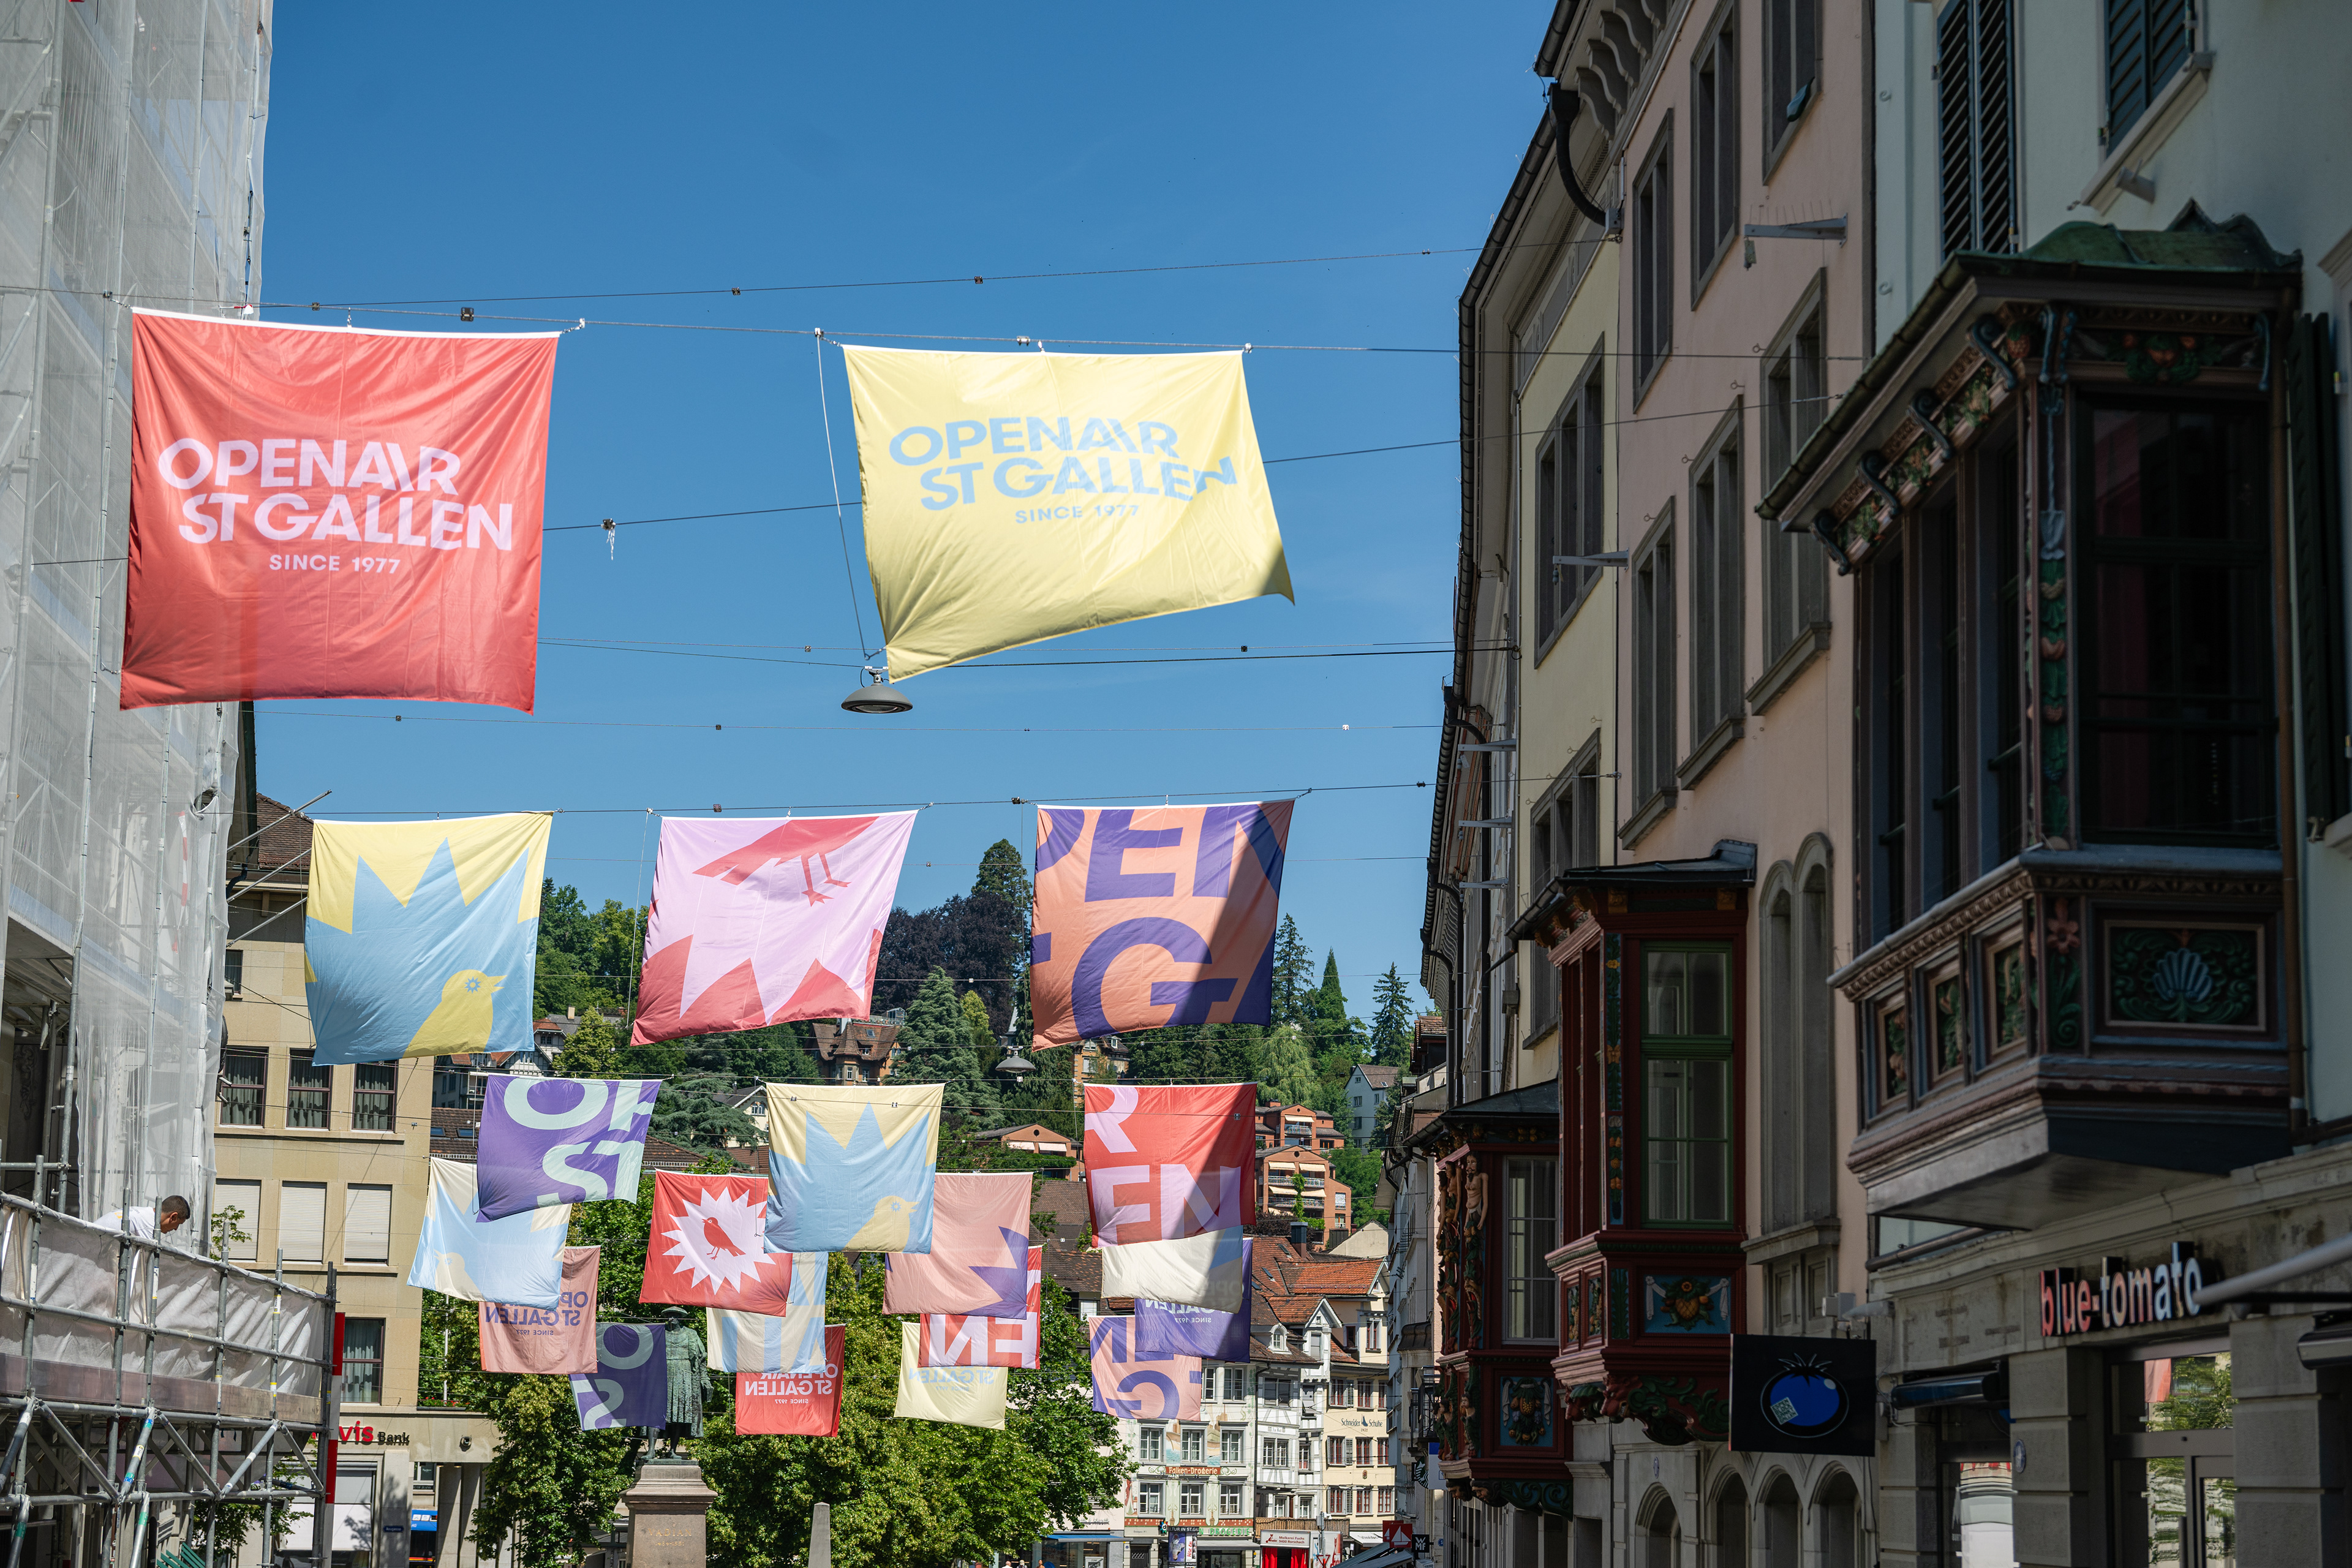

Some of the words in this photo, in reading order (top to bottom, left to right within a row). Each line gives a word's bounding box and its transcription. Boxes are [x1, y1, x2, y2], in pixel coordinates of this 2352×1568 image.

[888, 417, 1180, 466] OPENAIR
[158, 437, 461, 495] OPENAIR
[1015, 506, 1083, 524] SINCE
[1095, 505, 1139, 518] 1977
[269, 554, 339, 571] SINCE
[352, 556, 401, 574] 1977
[1341, 1417, 1360, 1427] Schneider
[1368, 1419, 1383, 1427] Schuhe
[378, 1431, 410, 1442] Bank
[1168, 1466, 1218, 1475] Falken-Drogerie
